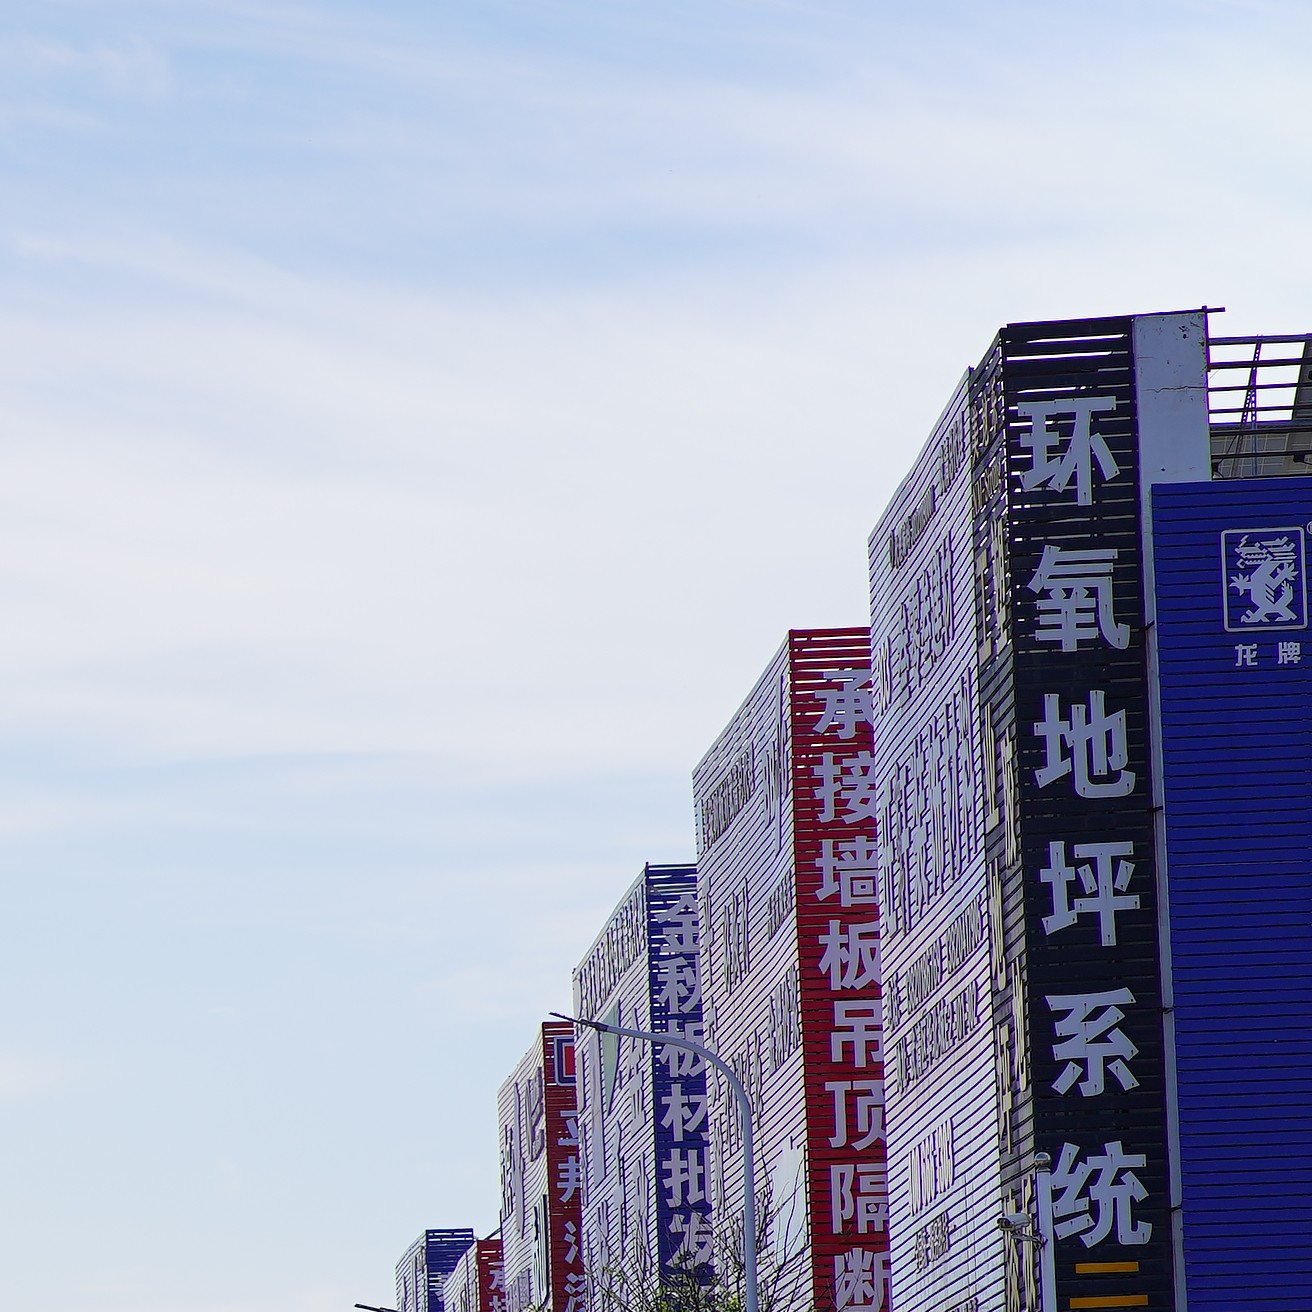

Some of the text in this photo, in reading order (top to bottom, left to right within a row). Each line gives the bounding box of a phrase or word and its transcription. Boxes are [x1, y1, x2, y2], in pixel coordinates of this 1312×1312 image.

[1017, 396, 1153, 1248] 环氧地坪系统
[1235, 641, 1302, 668] 龙牌
